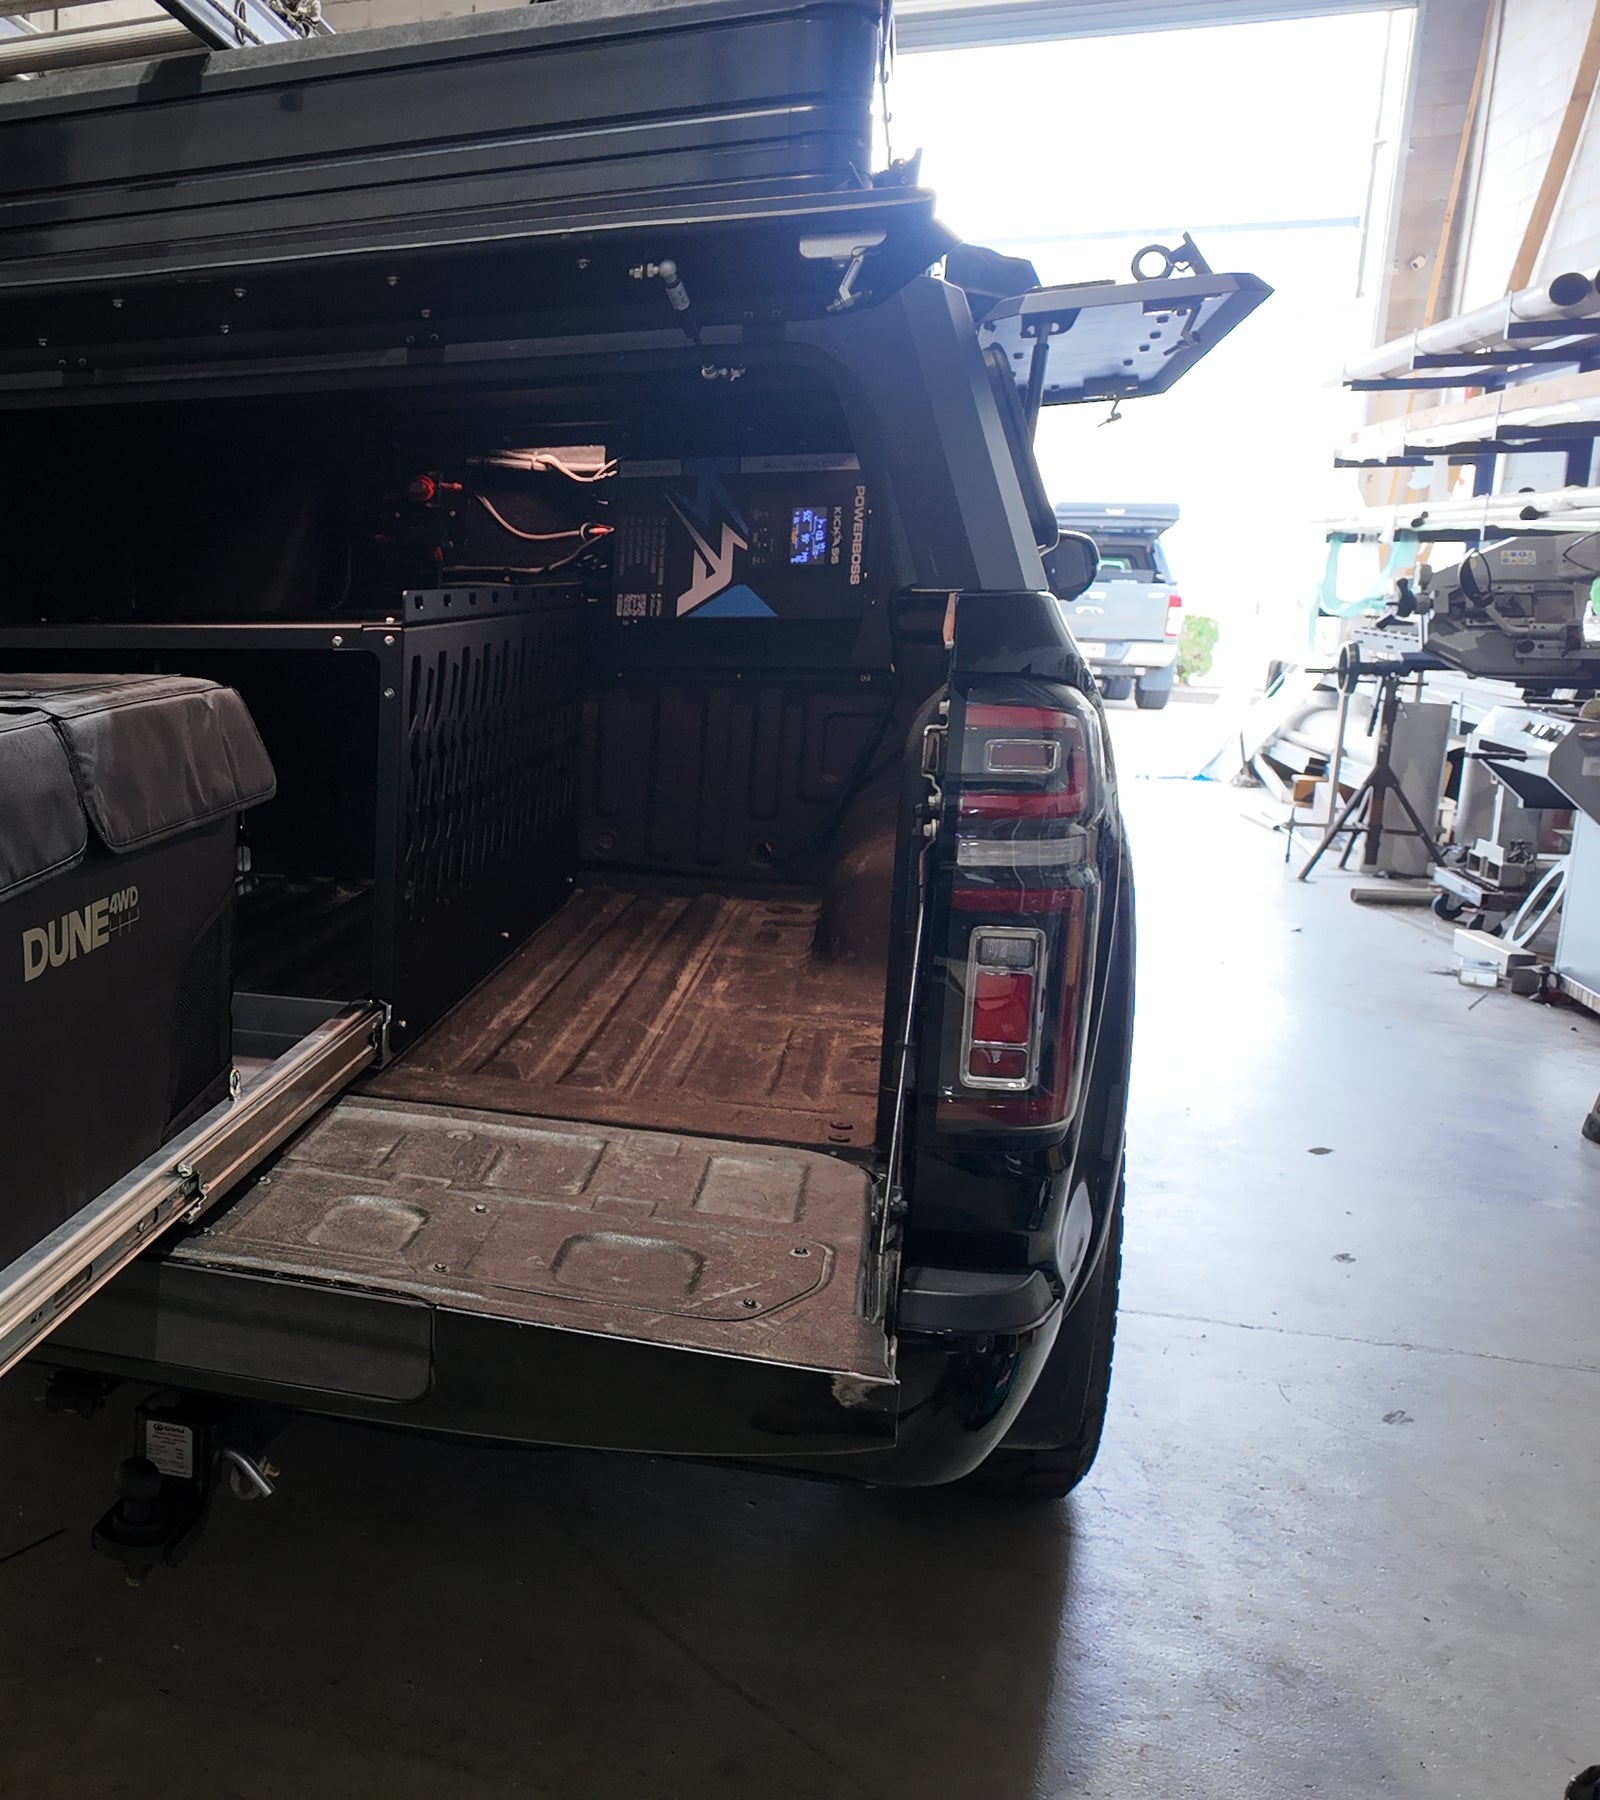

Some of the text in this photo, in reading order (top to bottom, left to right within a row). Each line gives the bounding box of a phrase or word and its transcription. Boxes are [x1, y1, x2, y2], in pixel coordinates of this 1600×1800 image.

[850, 485, 866, 585] POWERBOSS
[22, 885, 139, 982] DUNE 4WD
